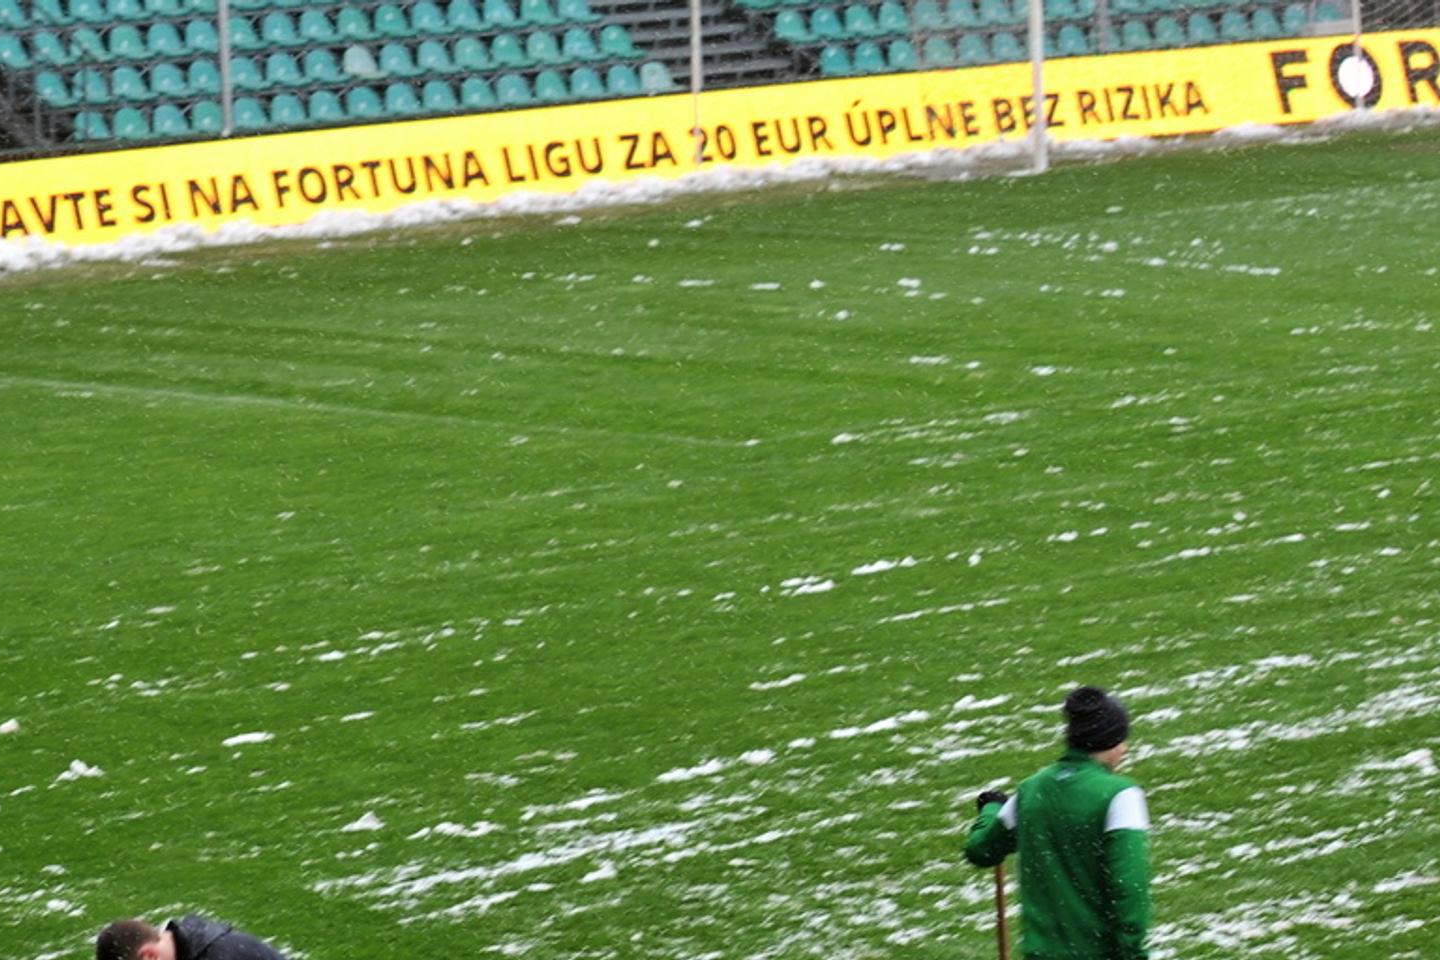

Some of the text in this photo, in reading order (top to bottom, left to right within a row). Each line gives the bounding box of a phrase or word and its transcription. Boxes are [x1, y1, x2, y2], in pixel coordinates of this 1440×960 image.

[131, 183, 172, 223] SI
[187, 174, 259, 217] NA
[272, 151, 491, 208] FORTUNA
[501, 137, 605, 182] LIGU
[619, 131, 678, 170] ZA
[688, 124, 738, 164] 20
[751, 115, 834, 157] EUR
[845, 98, 980, 147] ÚPLNE
[1075, 80, 1211, 125] RIZIKA
